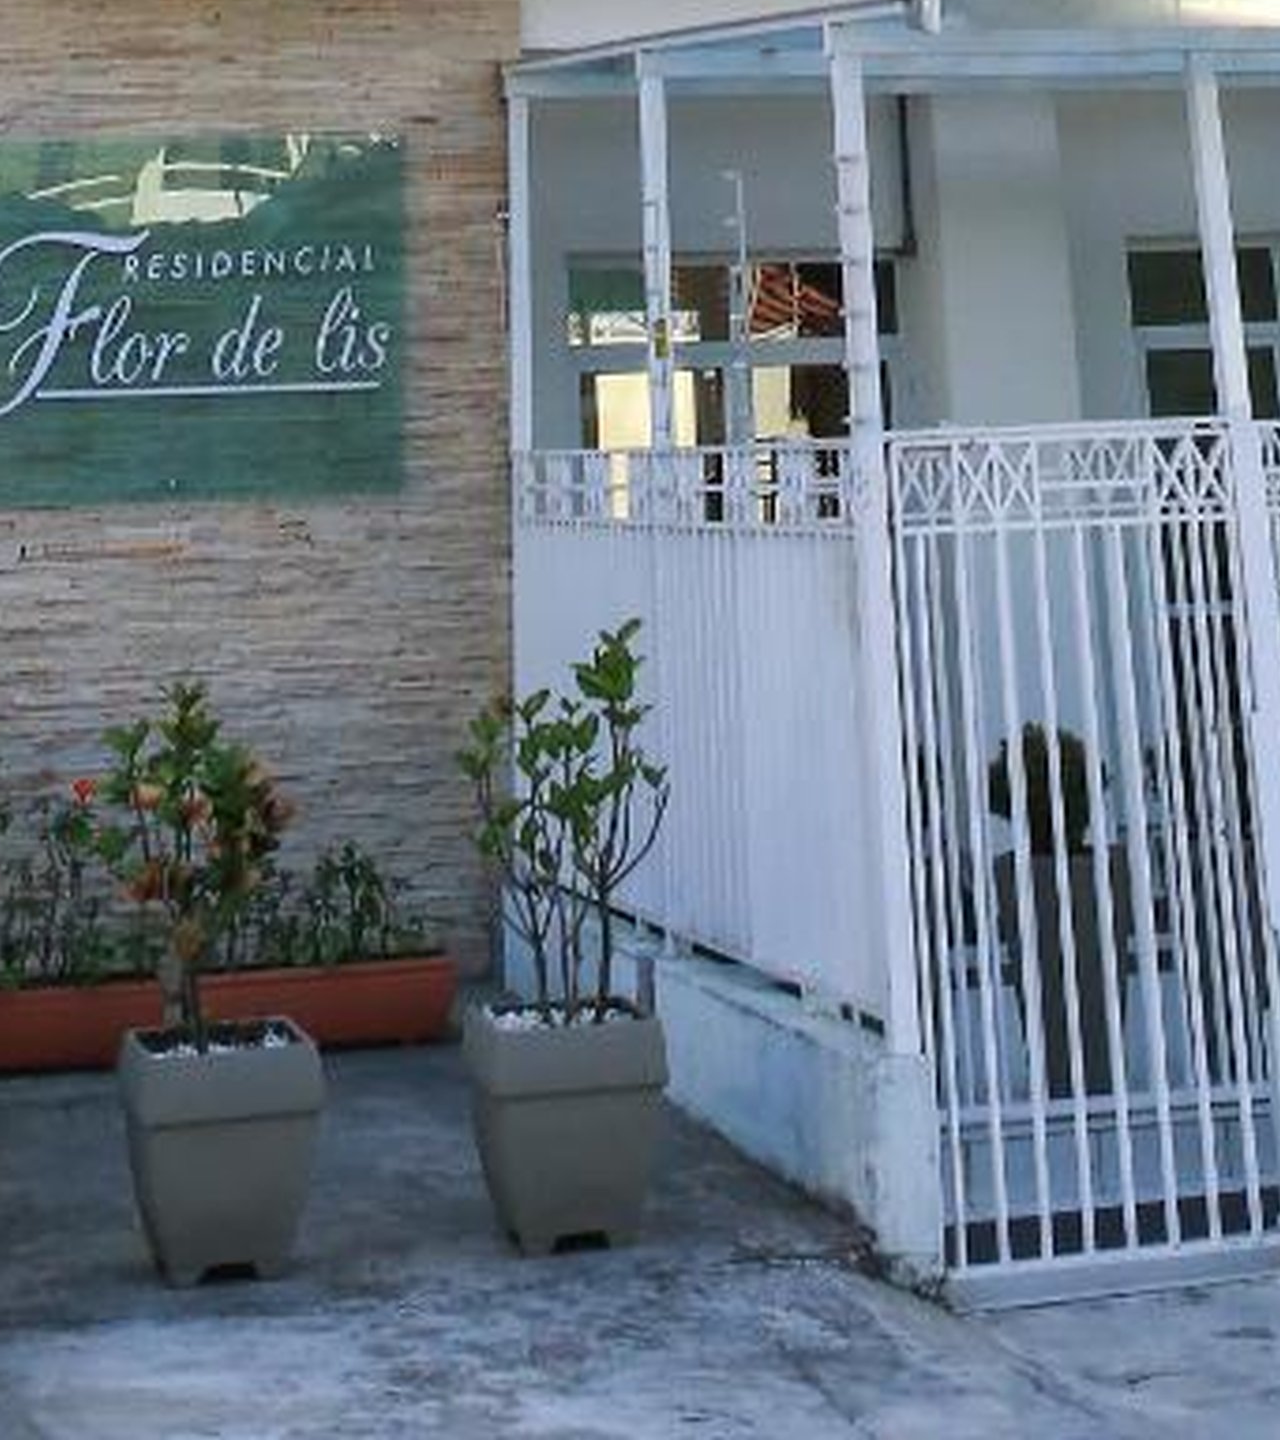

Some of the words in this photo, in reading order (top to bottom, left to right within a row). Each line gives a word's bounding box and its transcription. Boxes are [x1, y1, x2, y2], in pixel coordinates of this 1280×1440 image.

[124, 243, 377, 282] RESIDENCIAL
[213, 294, 285, 380] de
[315, 287, 393, 375] lis
